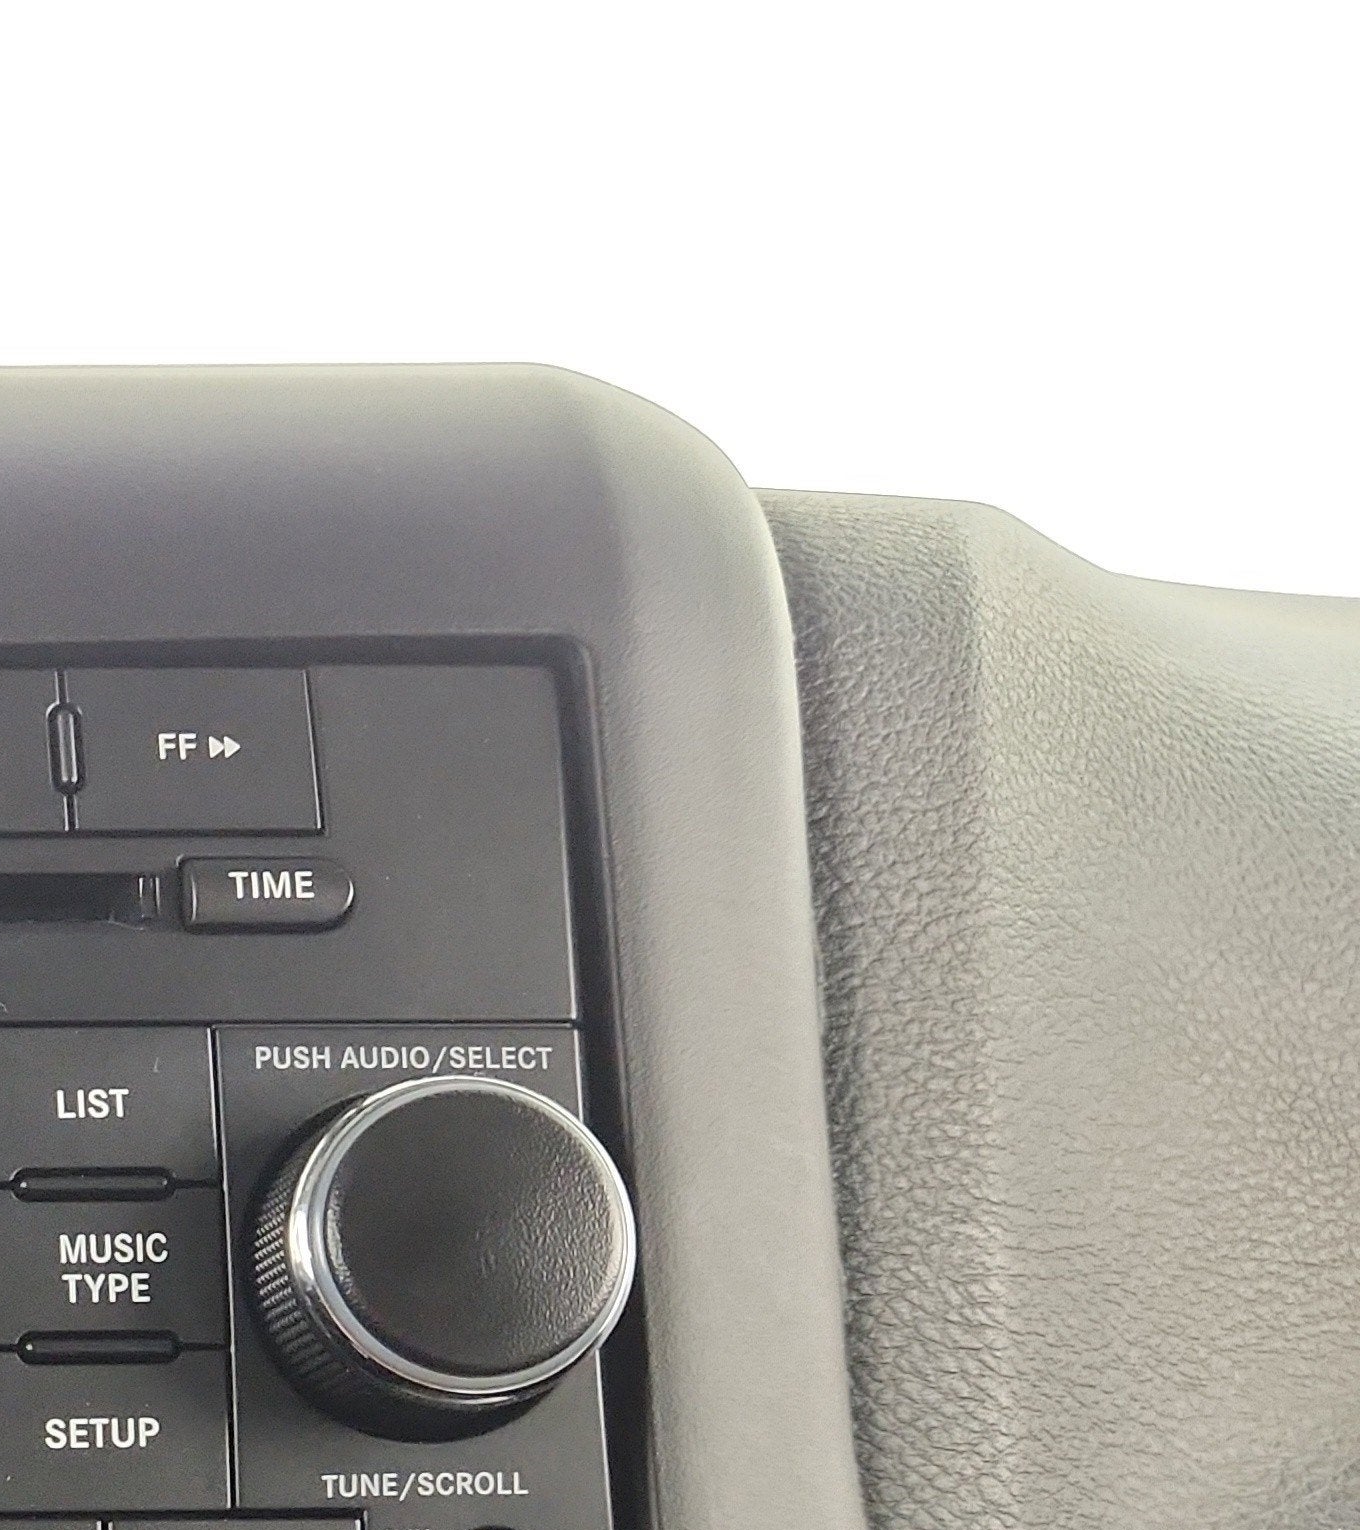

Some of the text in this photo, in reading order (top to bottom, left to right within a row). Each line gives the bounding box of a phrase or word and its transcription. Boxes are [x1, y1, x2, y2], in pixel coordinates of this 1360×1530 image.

[158, 732, 197, 761] FF
[227, 870, 315, 899] TIME
[255, 1045, 553, 1074] PUSH AUDIO/SELECT
[56, 1088, 130, 1119] LIST
[59, 1232, 168, 1264] MUSIC
[61, 1272, 151, 1304] TYPE
[44, 1417, 160, 1449] SETUP
[321, 1471, 530, 1501] TUNE/SCROLL
